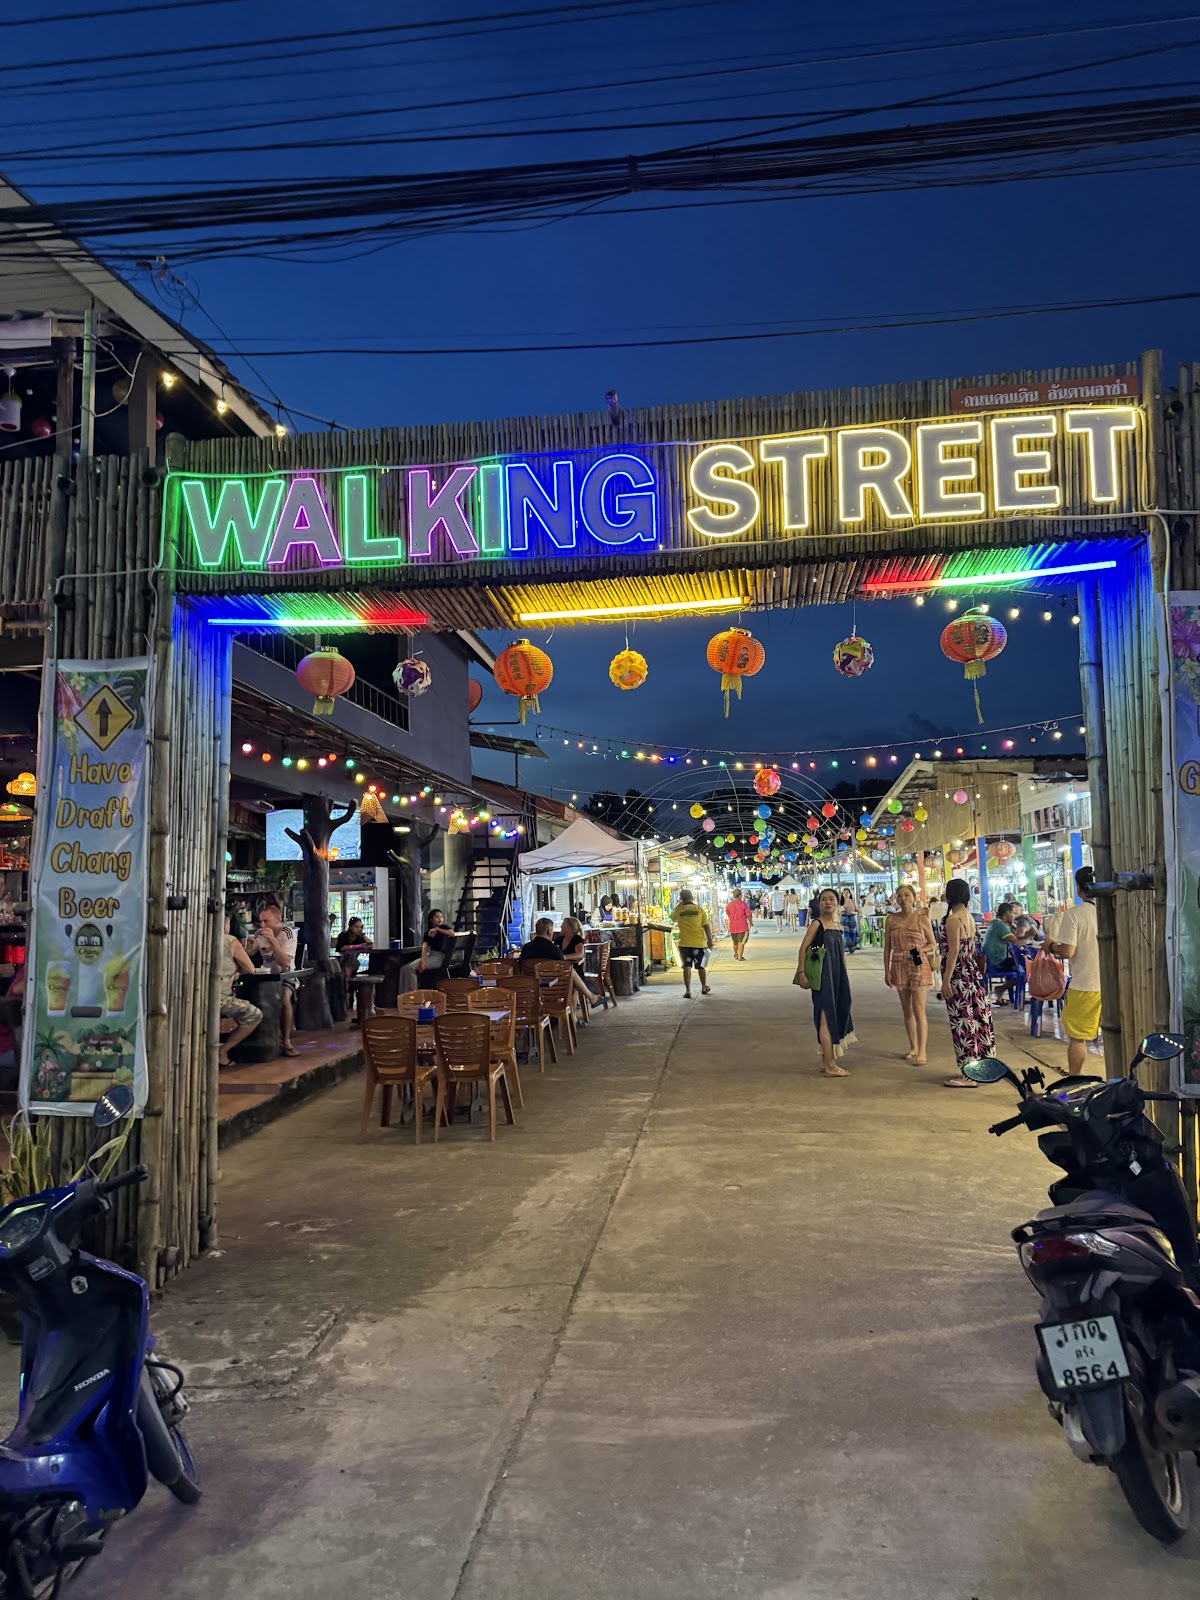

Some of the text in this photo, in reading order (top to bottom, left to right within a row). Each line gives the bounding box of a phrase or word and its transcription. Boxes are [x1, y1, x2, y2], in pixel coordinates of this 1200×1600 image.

[964, 387, 1039, 407] ถนนคนเดิน
[181, 407, 1137, 566] WALKING STREET
[69, 753, 131, 785] Have
[56, 796, 133, 829] Draft
[51, 841, 132, 881] Chang
[58, 886, 120, 919] Beer
[73, 1368, 111, 1392] HONDA
[1062, 1360, 1119, 1386] 8564
